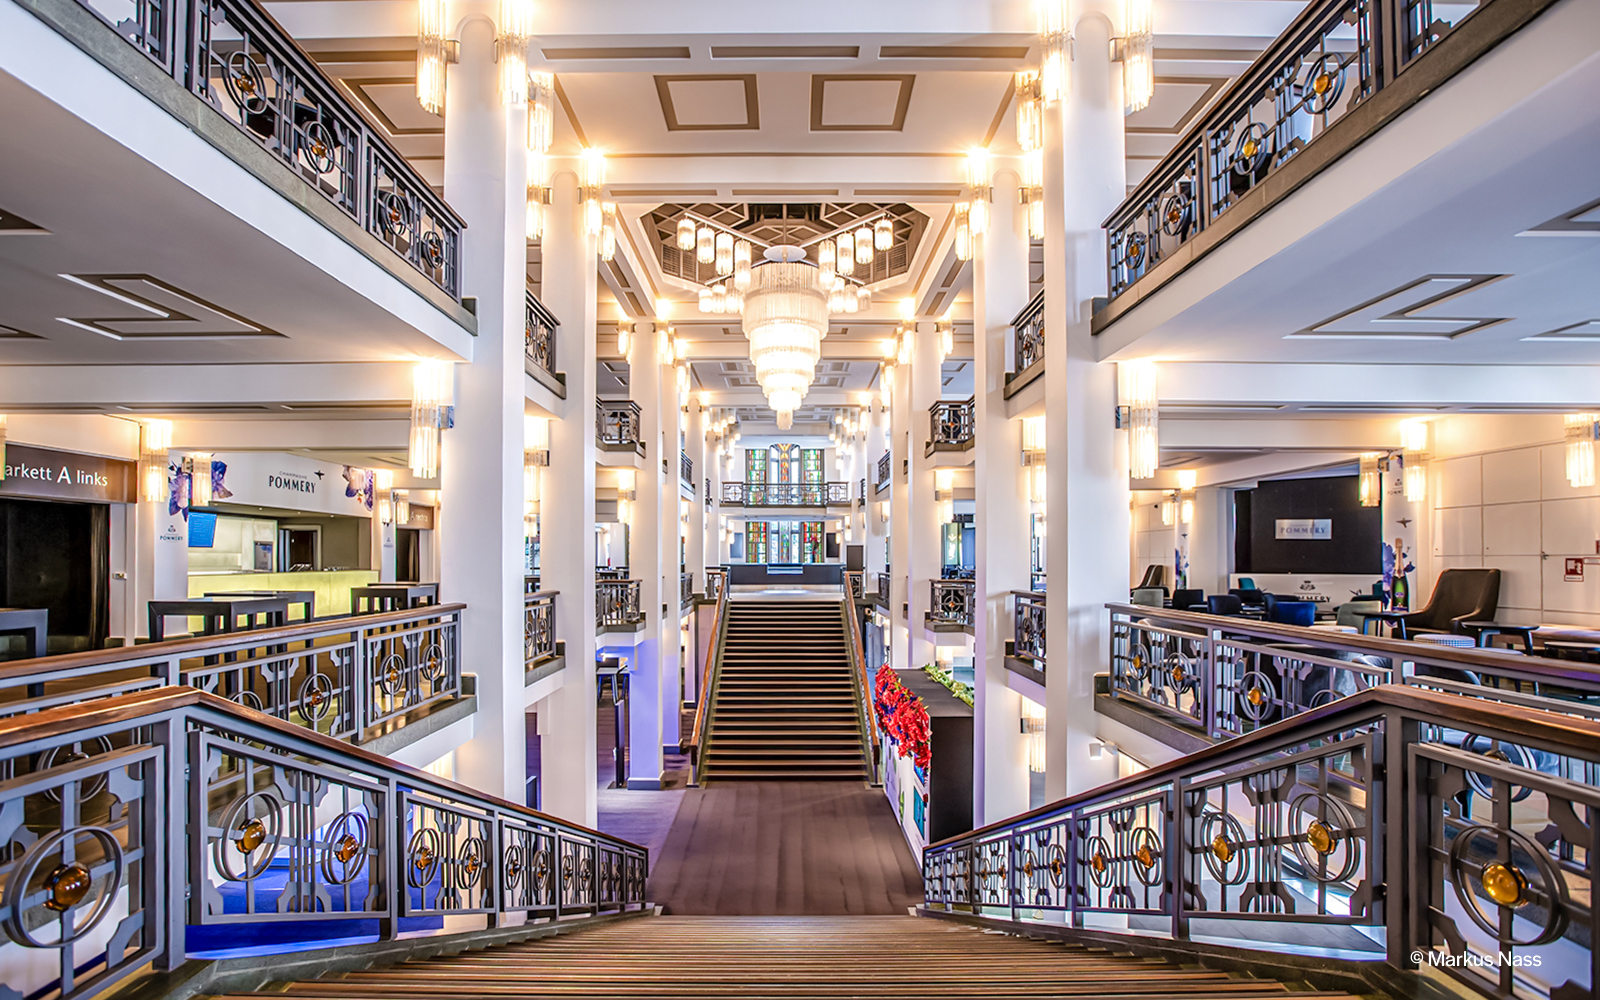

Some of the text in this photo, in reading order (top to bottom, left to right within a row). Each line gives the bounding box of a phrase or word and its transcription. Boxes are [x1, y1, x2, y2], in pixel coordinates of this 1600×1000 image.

[5, 463, 108, 486] arkett A links
[268, 475, 316, 493] POMMERY
[1280, 526, 1326, 534] POMMERY
